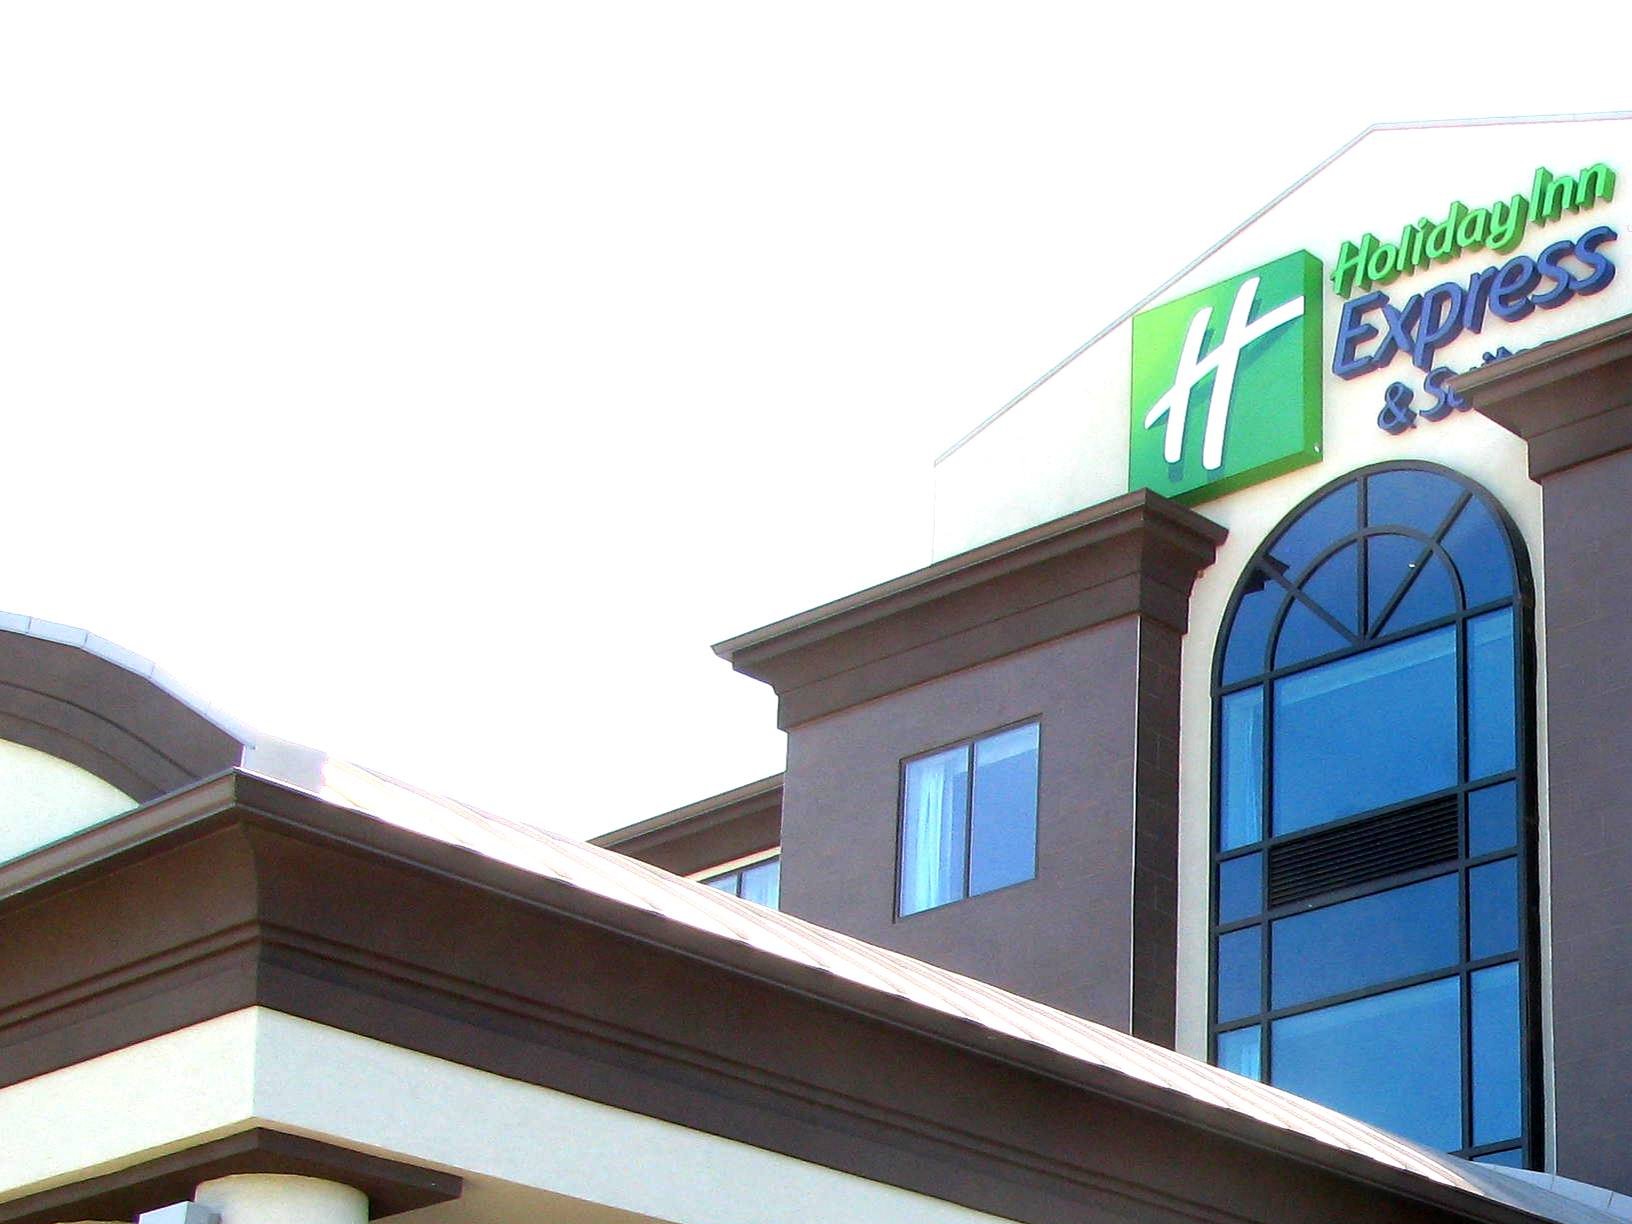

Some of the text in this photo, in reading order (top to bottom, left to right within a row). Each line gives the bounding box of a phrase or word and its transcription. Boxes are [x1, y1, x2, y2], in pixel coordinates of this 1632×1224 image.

[1331, 163, 1616, 299] Holiday Inn
[1332, 226, 1617, 380] Express
[1377, 381, 1417, 435] &
